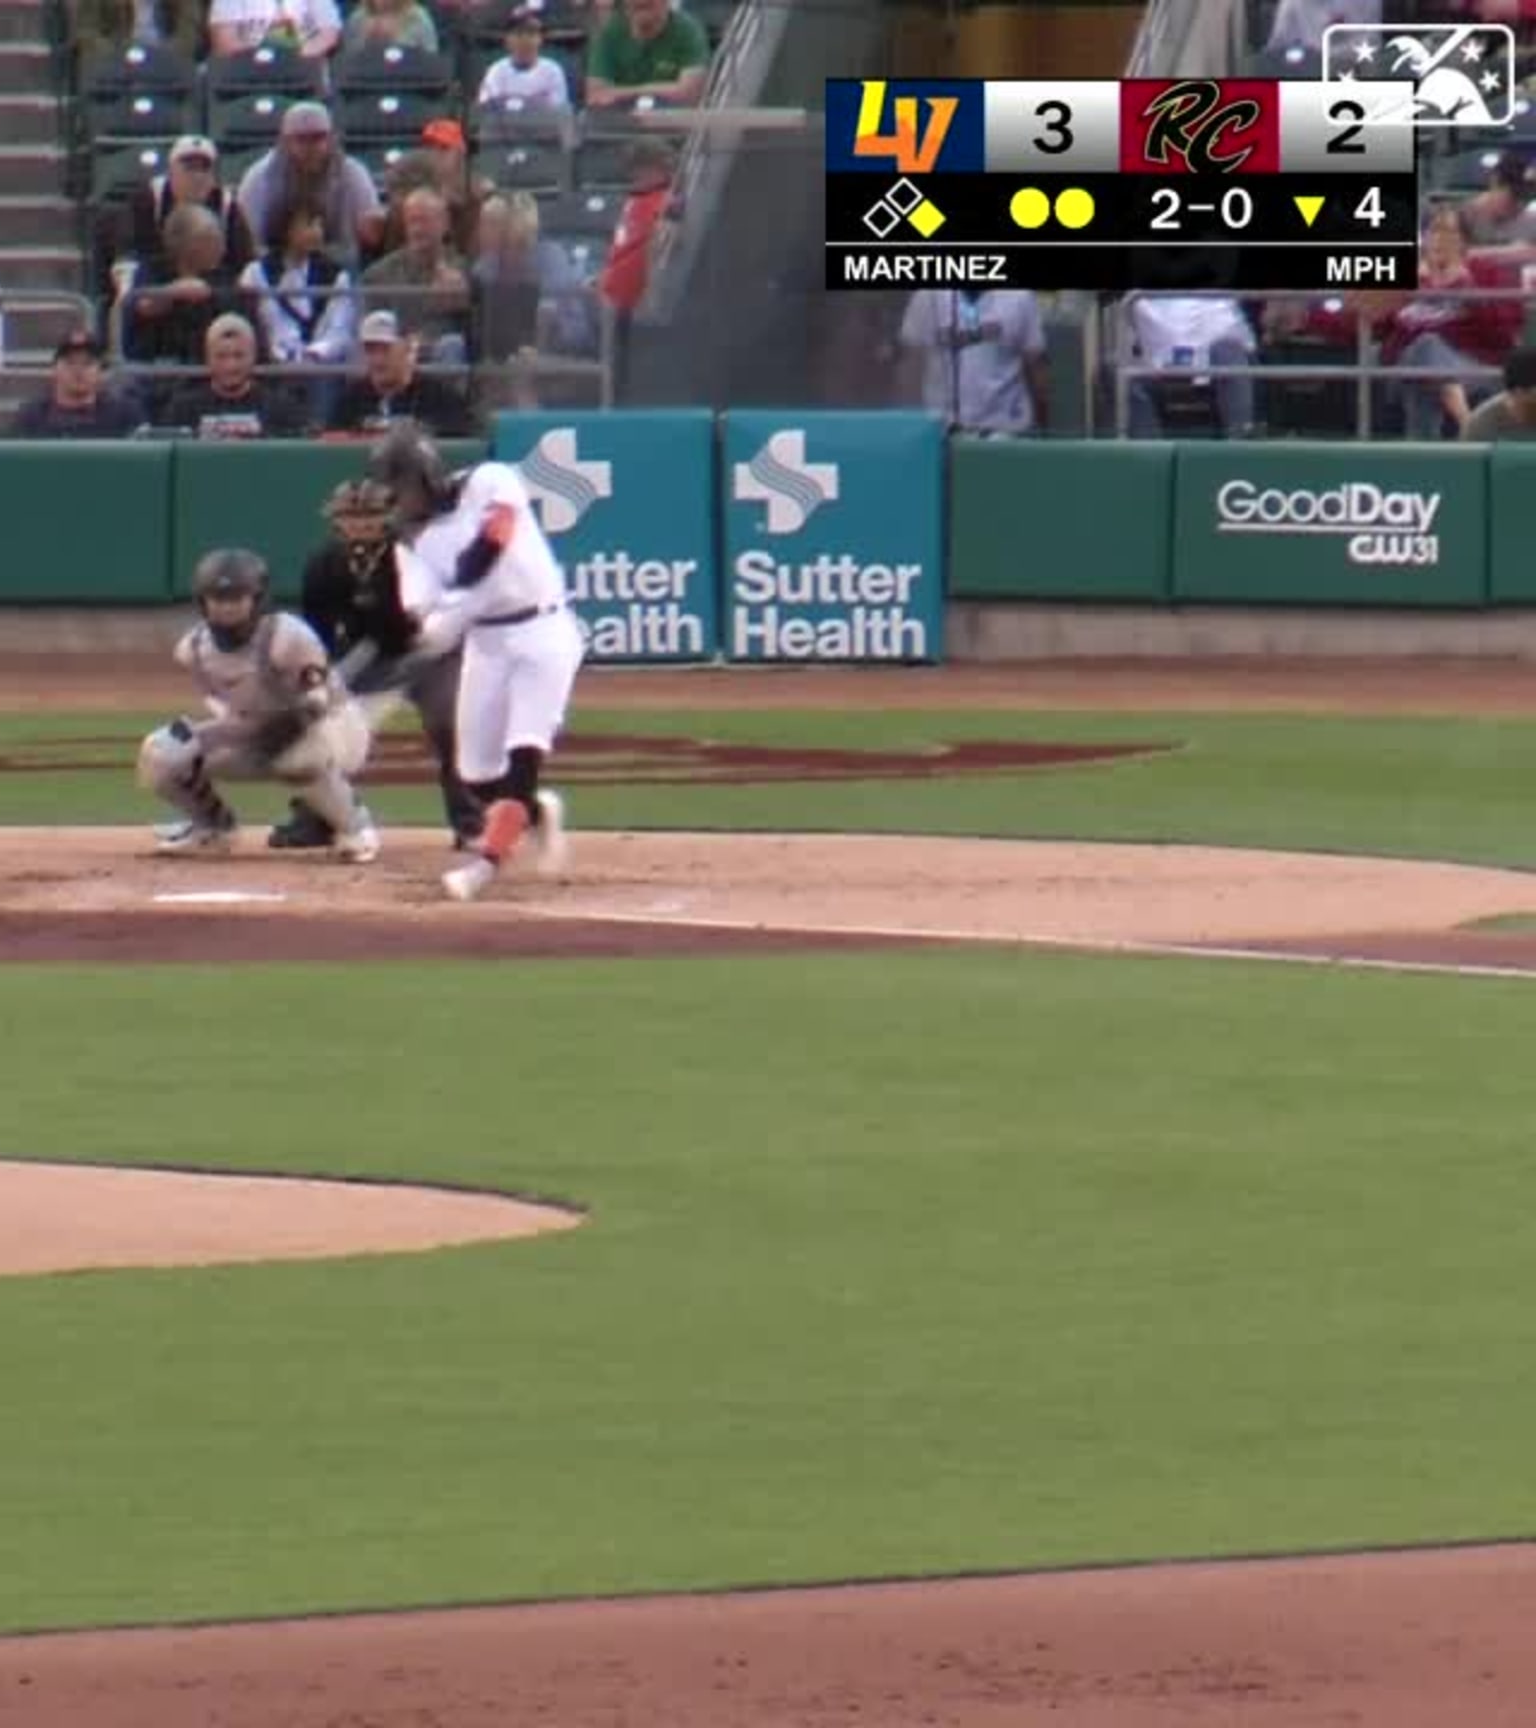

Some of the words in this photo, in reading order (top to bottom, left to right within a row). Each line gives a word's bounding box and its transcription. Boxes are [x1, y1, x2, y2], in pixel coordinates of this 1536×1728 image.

[1217, 480, 1440, 530] GoodDay
[567, 552, 697, 600] utter
[735, 550, 922, 603] Sutter
[577, 604, 703, 654] alth
[735, 605, 926, 657] Health
